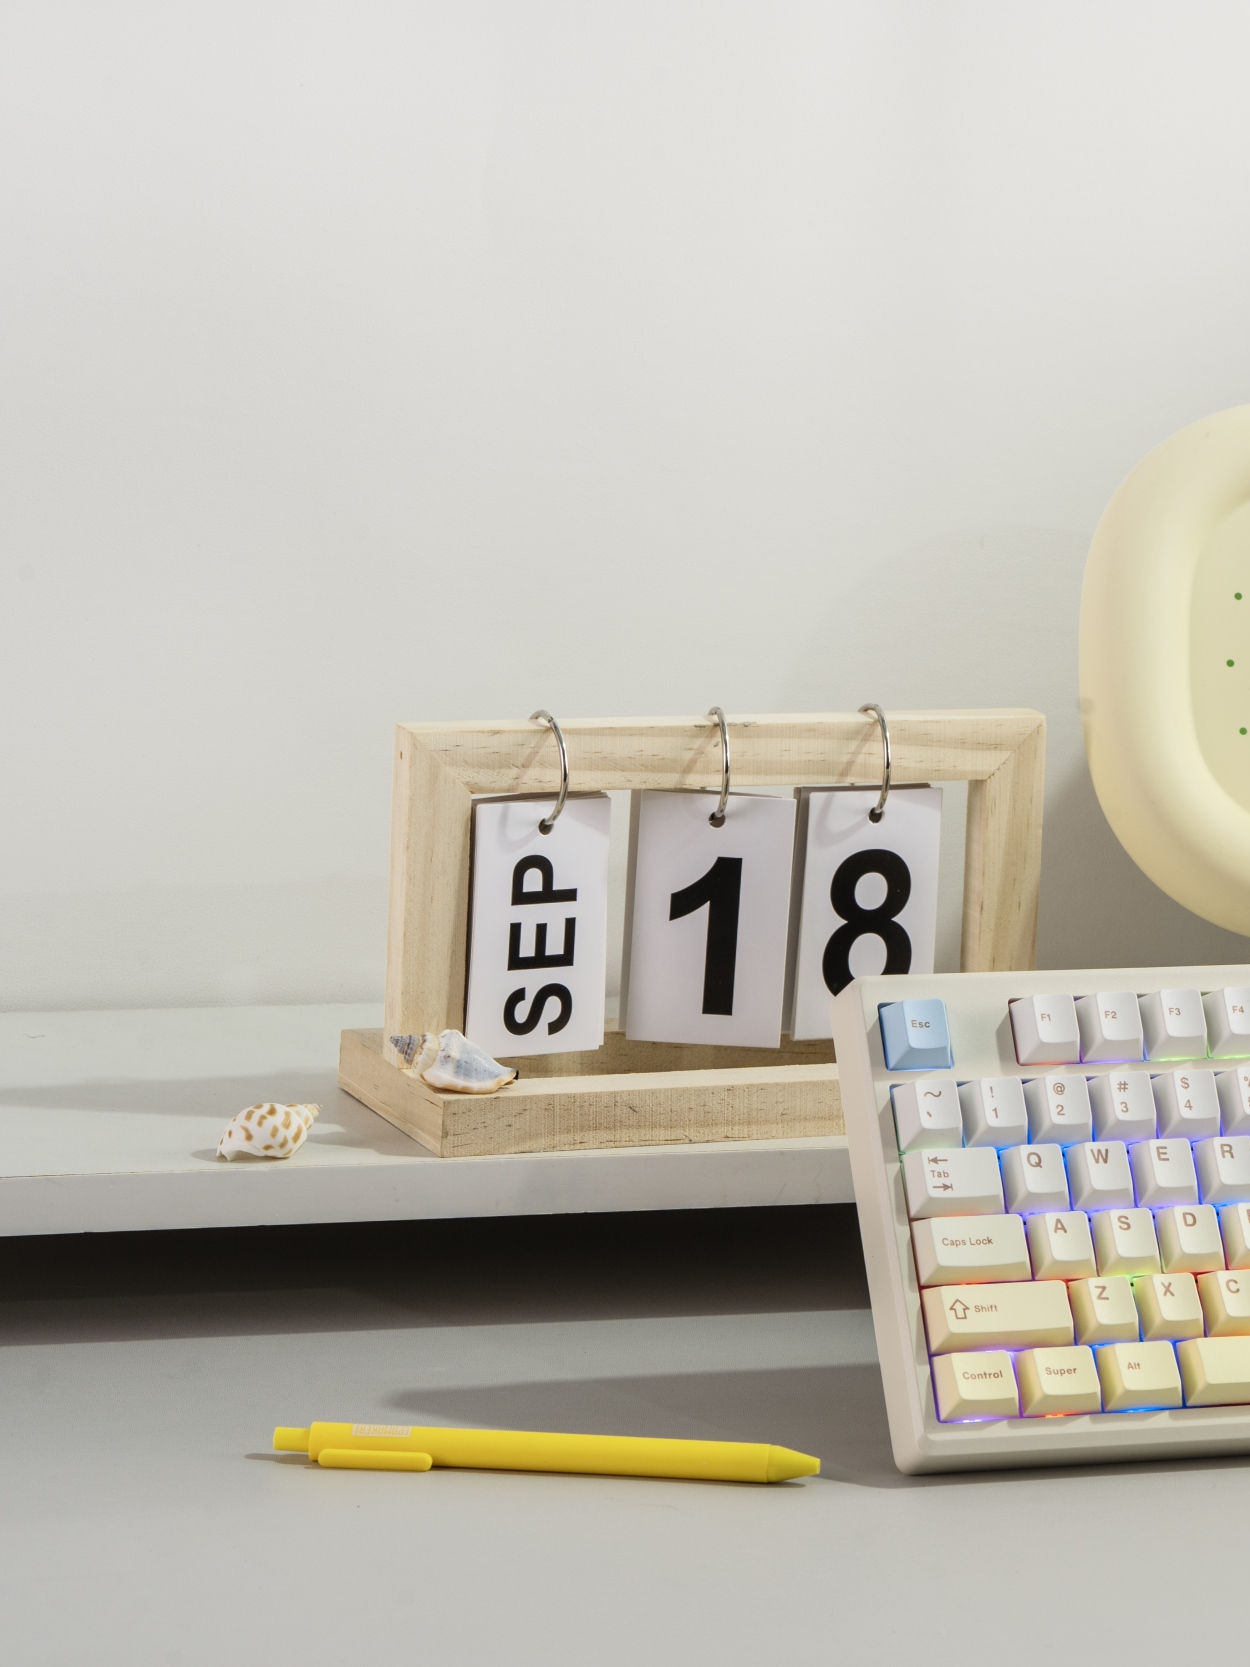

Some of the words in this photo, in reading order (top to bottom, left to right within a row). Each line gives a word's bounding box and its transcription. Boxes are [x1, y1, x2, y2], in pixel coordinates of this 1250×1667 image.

[822, 849, 912, 998] 8
[668, 856, 744, 1016] 1
[502, 854, 578, 1036] SEP
[1169, 1008, 1181, 1016] F3
[911, 1020, 930, 1028] Esc
[1053, 1083, 1065, 1095] @
[1117, 1081, 1128, 1092] #
[1181, 1077, 1189, 1090] $
[990, 1086, 994, 1098] !
[1056, 1105, 1065, 1116] 2
[1120, 1102, 1129, 1113] 3
[1184, 1099, 1193, 1110] 4
[992, 1107, 998, 1118] 1
[1091, 1149, 1108, 1164] W
[1156, 1146, 1169, 1161] E
[1220, 1144, 1234, 1159] R
[1026, 1152, 1042, 1168] Q
[930, 1170, 949, 1178] Tab
[1054, 1218, 1067, 1233] A
[1118, 1215, 1131, 1231] S
[1183, 1212, 1197, 1227] D
[942, 1237, 965, 1247] Caps
[969, 1236, 993, 1245] Lock
[1161, 1282, 1175, 1296] X
[1226, 1279, 1240, 1294] C
[1095, 1286, 1109, 1300] Z
[974, 1304, 998, 1313] Shift
[1045, 1366, 1077, 1377] Super
[1128, 1362, 1140, 1370] Alt
[963, 1370, 1003, 1380] Control
[359, 1425, 410, 1436] EPOMAKER
